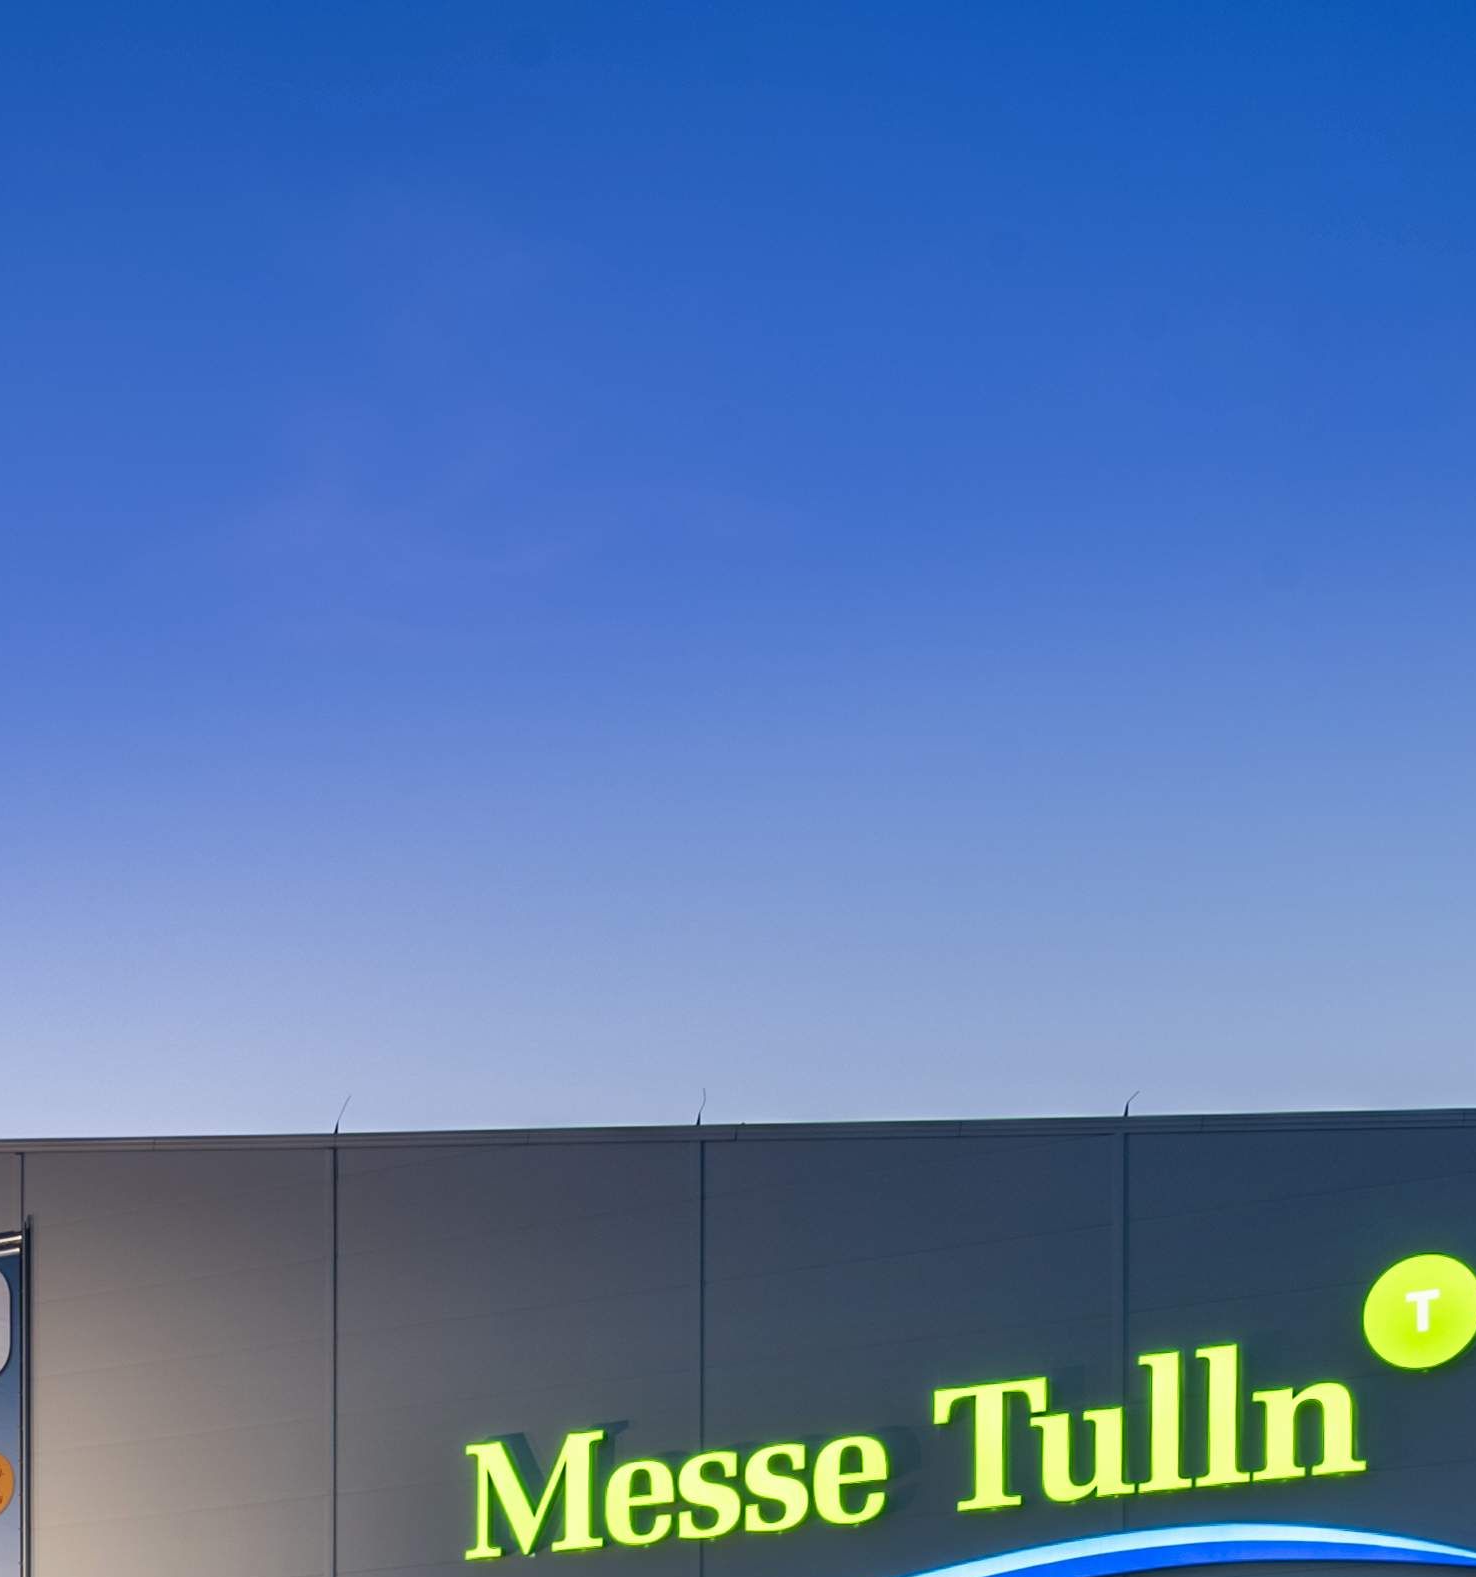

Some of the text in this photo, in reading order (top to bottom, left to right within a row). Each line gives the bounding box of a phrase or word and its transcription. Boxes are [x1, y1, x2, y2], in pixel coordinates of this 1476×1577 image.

[1405, 1288, 1441, 1333] T
[464, 1342, 1367, 1561] Messe Tulln
